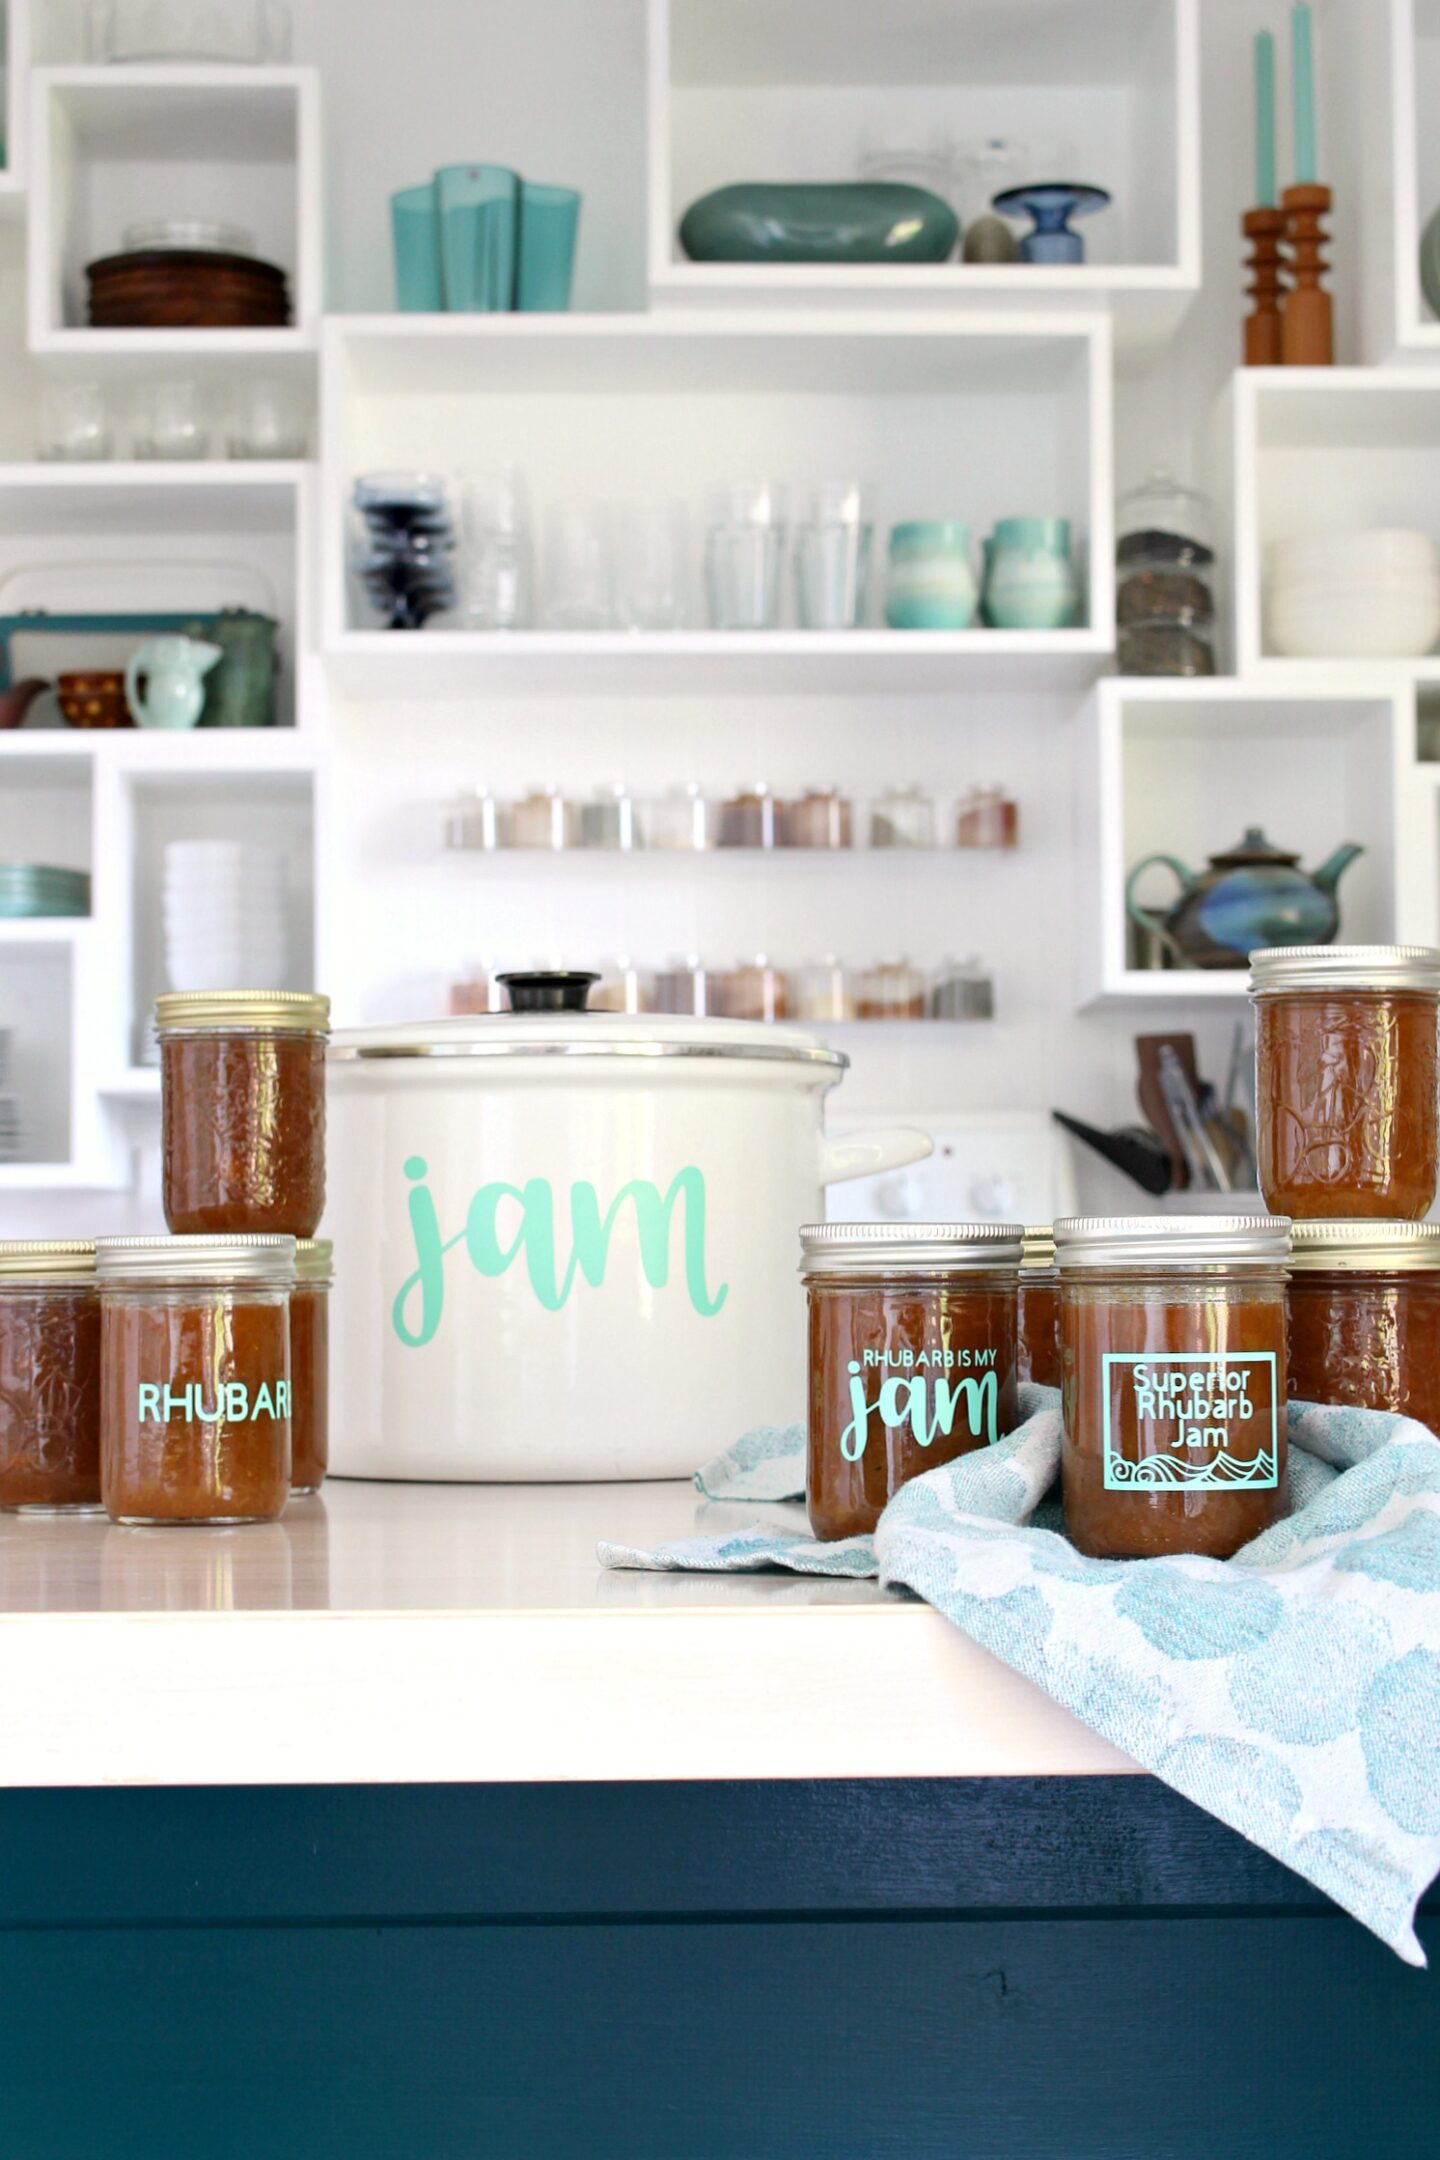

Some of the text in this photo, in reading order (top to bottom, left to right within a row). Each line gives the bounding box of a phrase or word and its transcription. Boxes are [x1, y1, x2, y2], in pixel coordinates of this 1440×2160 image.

[392, 1156, 729, 1348] jam
[863, 1349, 998, 1368] RHUBARB IS MY
[1133, 1363, 1251, 1398] Superior
[840, 1360, 1004, 1462] jam
[1138, 1390, 1253, 1420] Rhubarb
[1171, 1418, 1229, 1448] Jam
